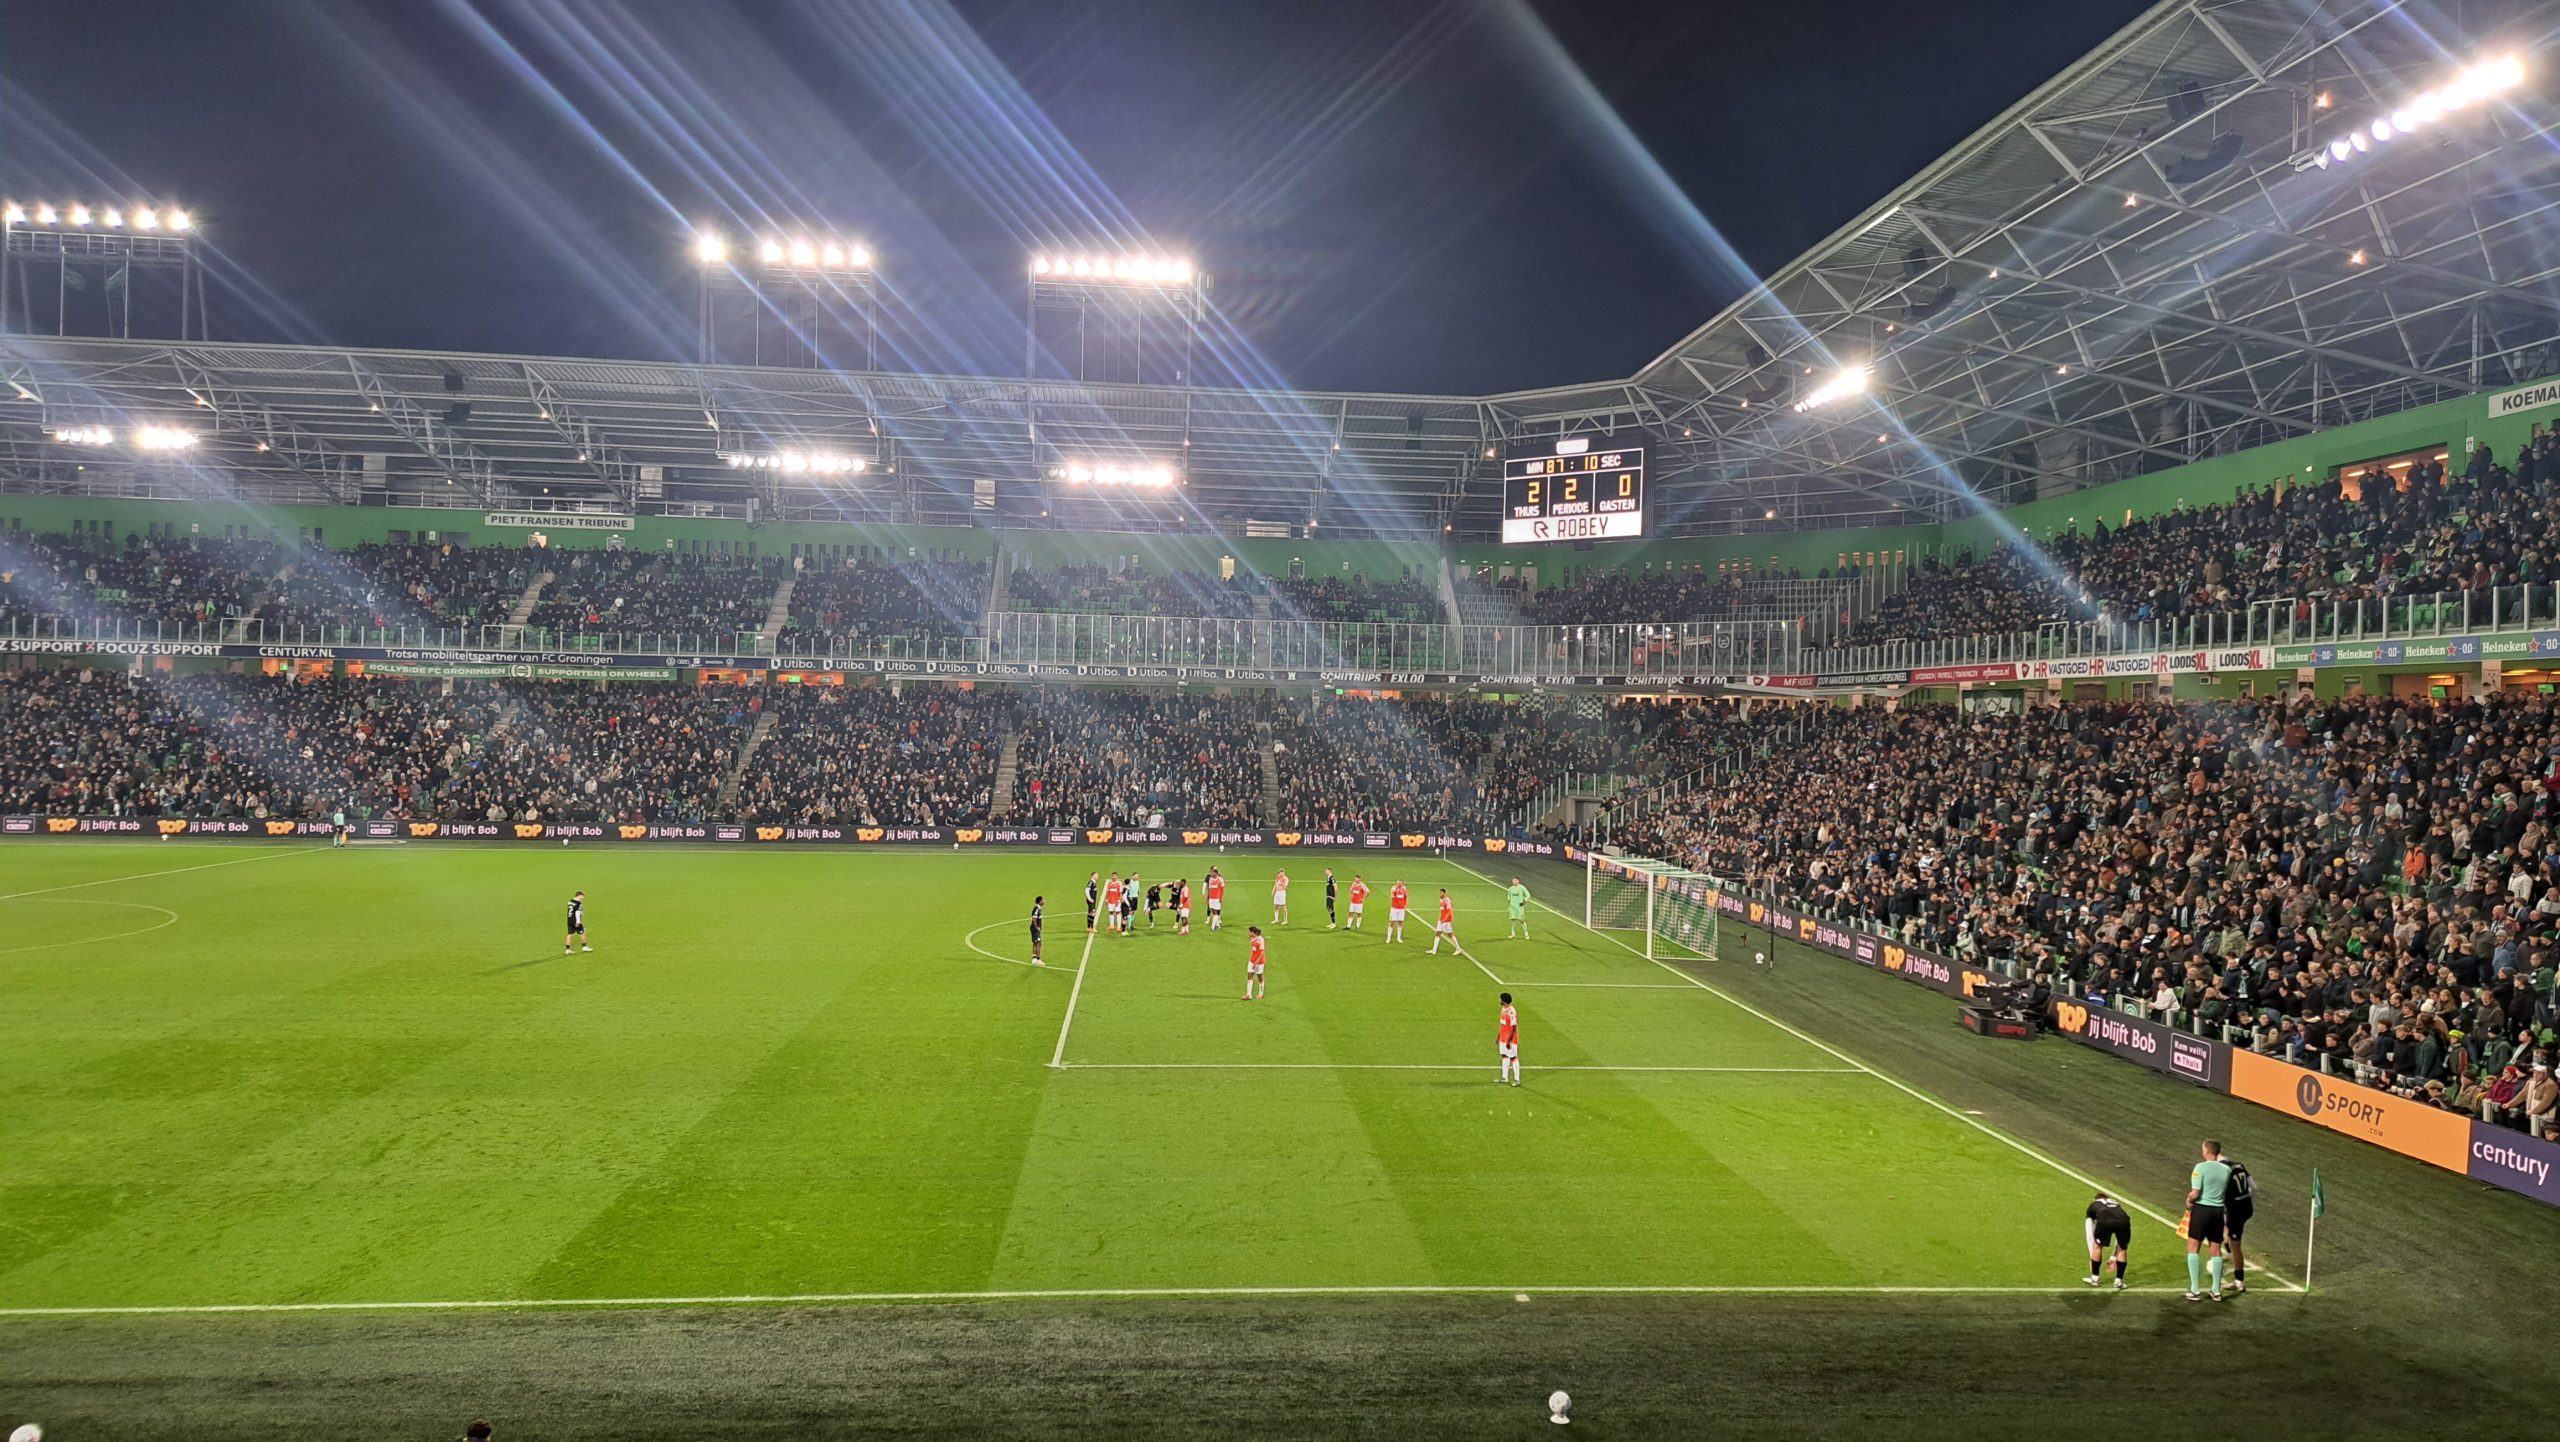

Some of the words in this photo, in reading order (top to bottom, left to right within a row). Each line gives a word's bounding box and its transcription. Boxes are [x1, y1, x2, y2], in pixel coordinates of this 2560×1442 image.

[2502, 385, 2560, 411] KOEMA
[1527, 461, 1544, 475] MIN
[1601, 455, 1621, 468] SEC
[1528, 481, 1540, 503] 2
[1565, 478, 1577, 500] 2
[1619, 474, 1632, 496] 0
[1514, 506, 1540, 518] THUIS
[1552, 501, 1590, 515] PERIODE
[1600, 499, 1636, 512] GASTEN
[491, 515, 516, 524] PIET
[520, 516, 574, 526] FRANSEN
[577, 518, 629, 528] TRIBUNE
[1558, 516, 1609, 538] ROBEY
[10, 640, 82, 653] SUPPORT
[97, 642, 149, 655] FOCUZ
[152, 644, 222, 656] SUPPORT
[259, 647, 336, 658] CENTURY.NL
[2405, 645, 2446, 657] Heineken
[2482, 640, 2527, 653] Heineken
[385, 649, 419, 659] Trotse
[421, 650, 518, 663] mobiliteitspartner
[520, 654, 539, 662] van
[542, 654, 556, 662] FC
[558, 654, 614, 666] Groningen
[2276, 652, 2309, 663] Heineken
[2337, 649, 2373, 660] Heineken
[369, 664, 427, 674] ROLLYSIDE
[443, 667, 506, 675] GRONINGEN
[537, 668, 608, 678] SUPPORTERS
[2034, 662, 2048, 678] HR
[2048, 662, 2088, 675] VASTGOED
[2089, 658, 2104, 676] HR
[2105, 658, 2149, 672] VASTGOED
[2151, 654, 2168, 673] HR
[47, 818, 78, 832] TOP
[80, 820, 90, 832] jij
[92, 820, 117, 832] blijft
[119, 821, 140, 831] Bob
[157, 819, 187, 833] TOP
[189, 821, 199, 833] jij
[201, 820, 226, 833] blijft
[228, 822, 249, 832] Bob
[265, 821, 295, 835] TOP
[297, 822, 307, 834] jij
[409, 823, 437, 836] TOP
[440, 824, 450, 836] jij
[452, 824, 476, 836] blijft
[479, 825, 498, 835] Bob
[515, 824, 543, 838] TOP
[545, 826, 555, 838] jij
[557, 826, 580, 838] blijft
[583, 826, 602, 836] Bob
[619, 825, 647, 839] TOP
[649, 827, 659, 839] jij
[661, 827, 684, 838] blijft
[686, 828, 705, 837] Bob
[756, 827, 783, 840] TOP
[786, 829, 795, 840] jij
[797, 828, 819, 840] blijft
[822, 829, 841, 839] Bob
[856, 828, 883, 841] TOP
[886, 829, 895, 841] jij
[897, 829, 919, 841] blijft
[922, 831, 940, 840] Bob
[955, 829, 982, 842] TOP
[985, 831, 994, 842] jij
[996, 830, 1018, 842] blijft
[1020, 831, 1038, 841] Bob
[1086, 830, 1113, 844] TOP
[1115, 832, 1124, 843] jij
[1126, 832, 1147, 843] blijft
[1150, 832, 1167, 842] Bob
[1182, 831, 1208, 845] TOP
[1210, 833, 1219, 844] jij
[1221, 833, 1241, 844] blijft
[1244, 834, 1262, 843] Bob
[1276, 832, 1302, 846] TOP
[1304, 834, 1312, 845] jij
[1314, 834, 1334, 845] blijft
[1337, 835, 1354, 845] Bob
[1400, 835, 1425, 848] TOP
[1427, 836, 1436, 848] jij
[1457, 838, 1472, 848] Bob
[1484, 839, 1506, 852] TOP
[1508, 841, 1516, 853] jij
[1516, 842, 1535, 855] blijft
[1537, 844, 1552, 854] Bob
[1884, 944, 1905, 970] TOP
[1905, 953, 1914, 975] jij
[1914, 955, 1932, 979] blijft
[1933, 964, 1949, 983] Bob
[2057, 1001, 2087, 1033] TOP
[2089, 1014, 2100, 1038] jij
[2102, 1017, 2128, 1046] blijft
[2132, 1028, 2156, 1054] Bob
[2174, 1040, 2188, 1052] Kom
[2325, 1093, 2385, 1127] SPORT
[2367, 1127, 2384, 1138] .COM
[2473, 1139, 2550, 1186] century
[2233, 1171, 2247, 1194] 17
